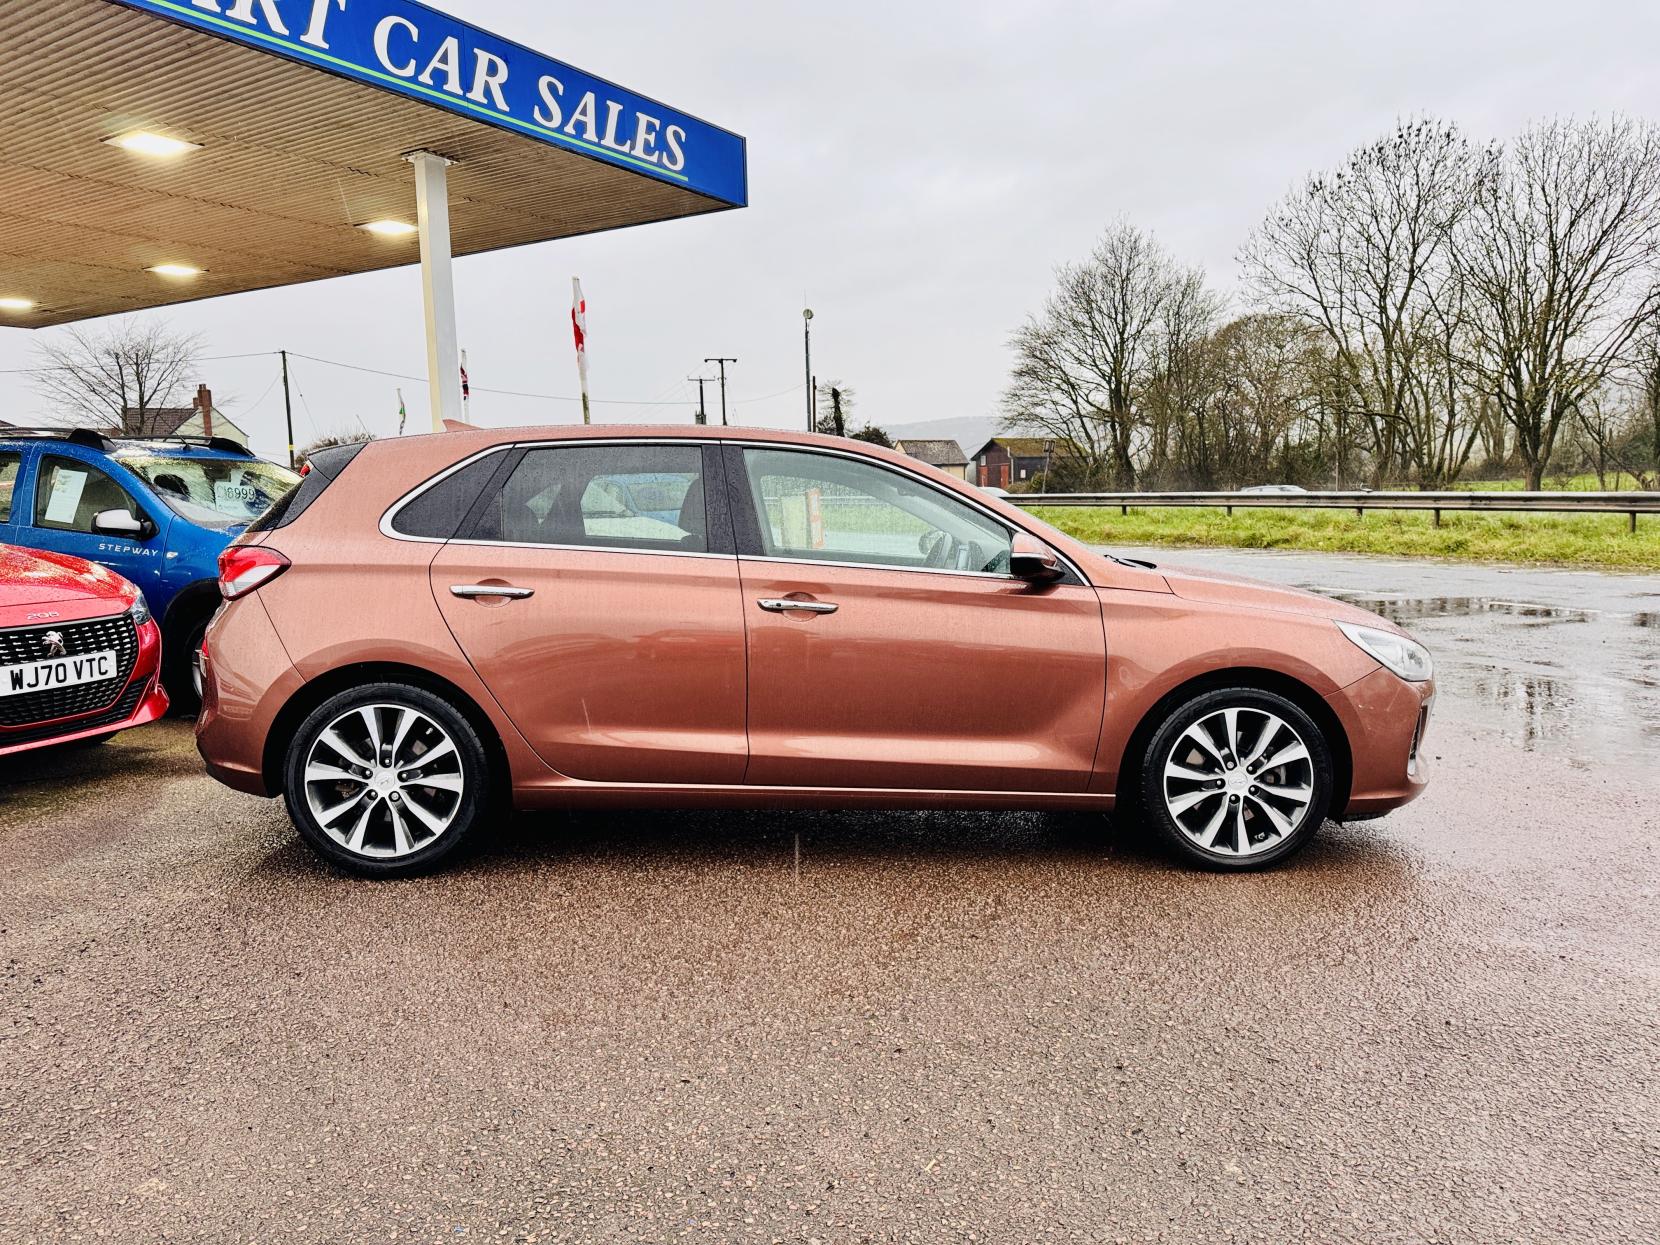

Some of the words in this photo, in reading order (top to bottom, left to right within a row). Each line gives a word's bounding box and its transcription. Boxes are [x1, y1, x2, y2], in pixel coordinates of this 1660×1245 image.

[373, 15, 510, 112] CAR
[533, 75, 687, 171] SALES
[98, 543, 158, 557] STEPWAY
[10, 661, 67, 691] WJ70
[73, 656, 109, 680] VTC
